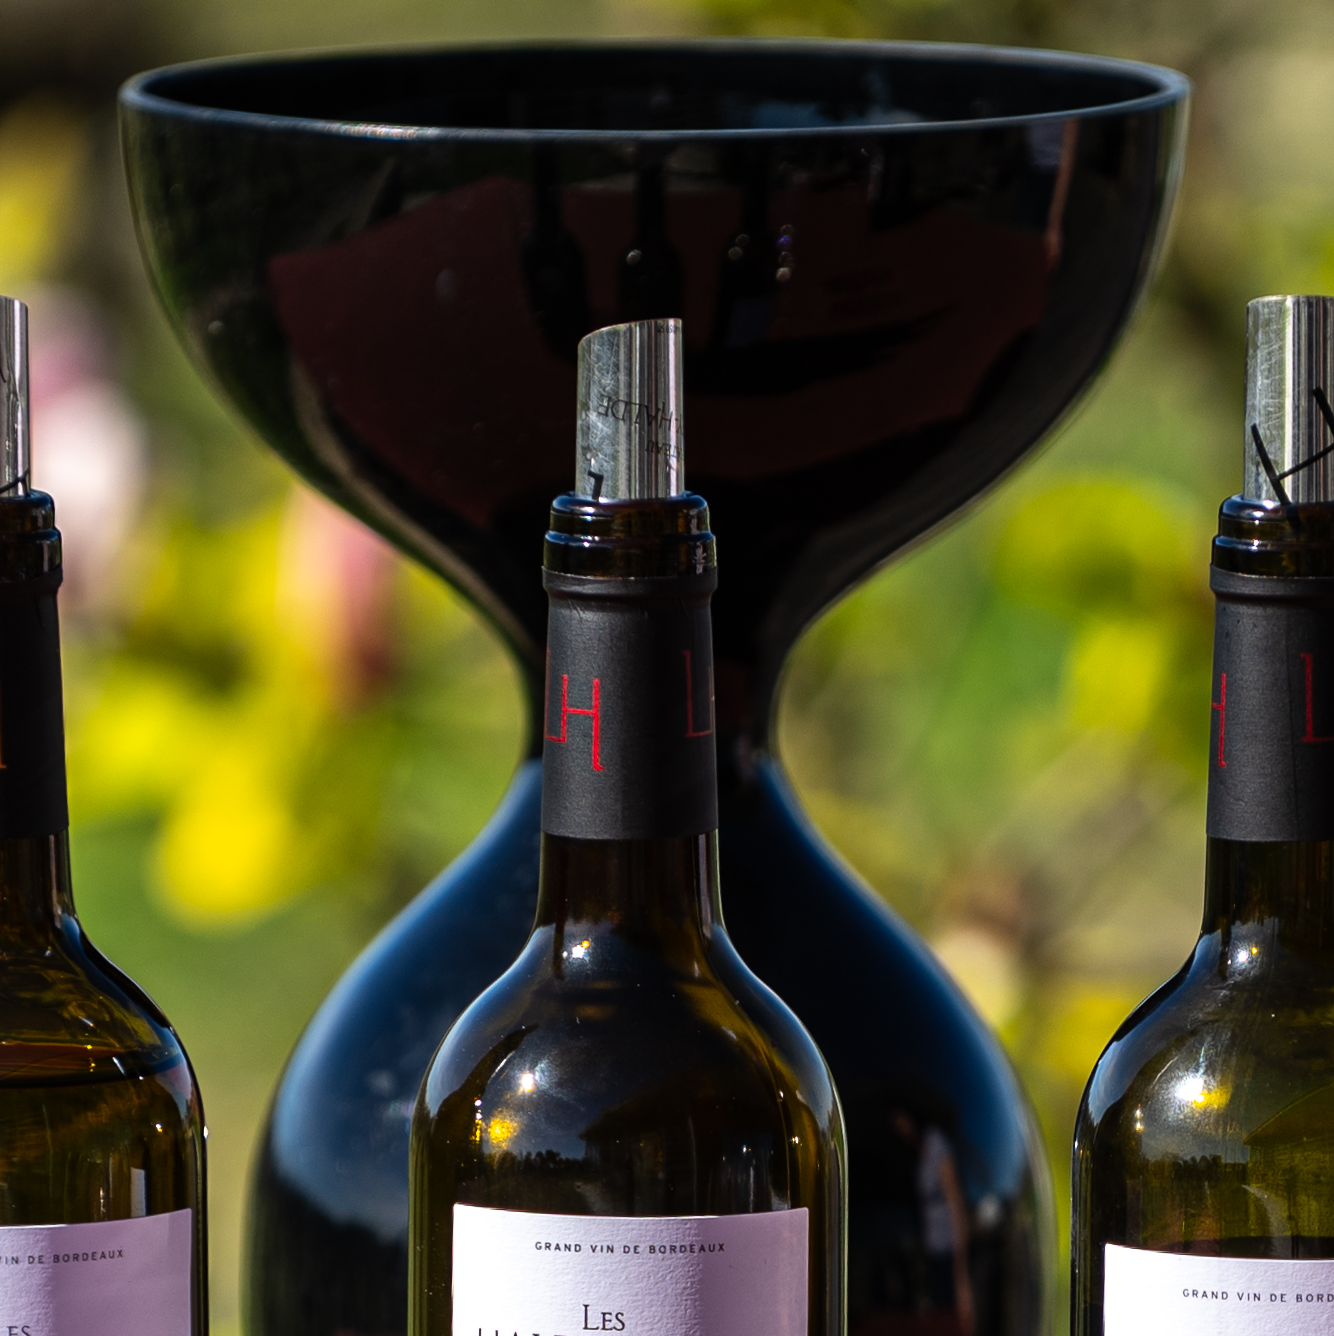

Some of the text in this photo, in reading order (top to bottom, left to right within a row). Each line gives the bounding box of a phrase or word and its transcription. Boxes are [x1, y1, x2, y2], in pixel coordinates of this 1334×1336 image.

[535, 1241, 725, 1254] GRAND VIN DE BORDEAUX
[27, 1254, 45, 1265] DE
[53, 1249, 124, 1264] BORDEAUX
[1182, 1289, 1228, 1300] GRAND
[1237, 1292, 1261, 1302] VIN
[1270, 1293, 1287, 1302] DE
